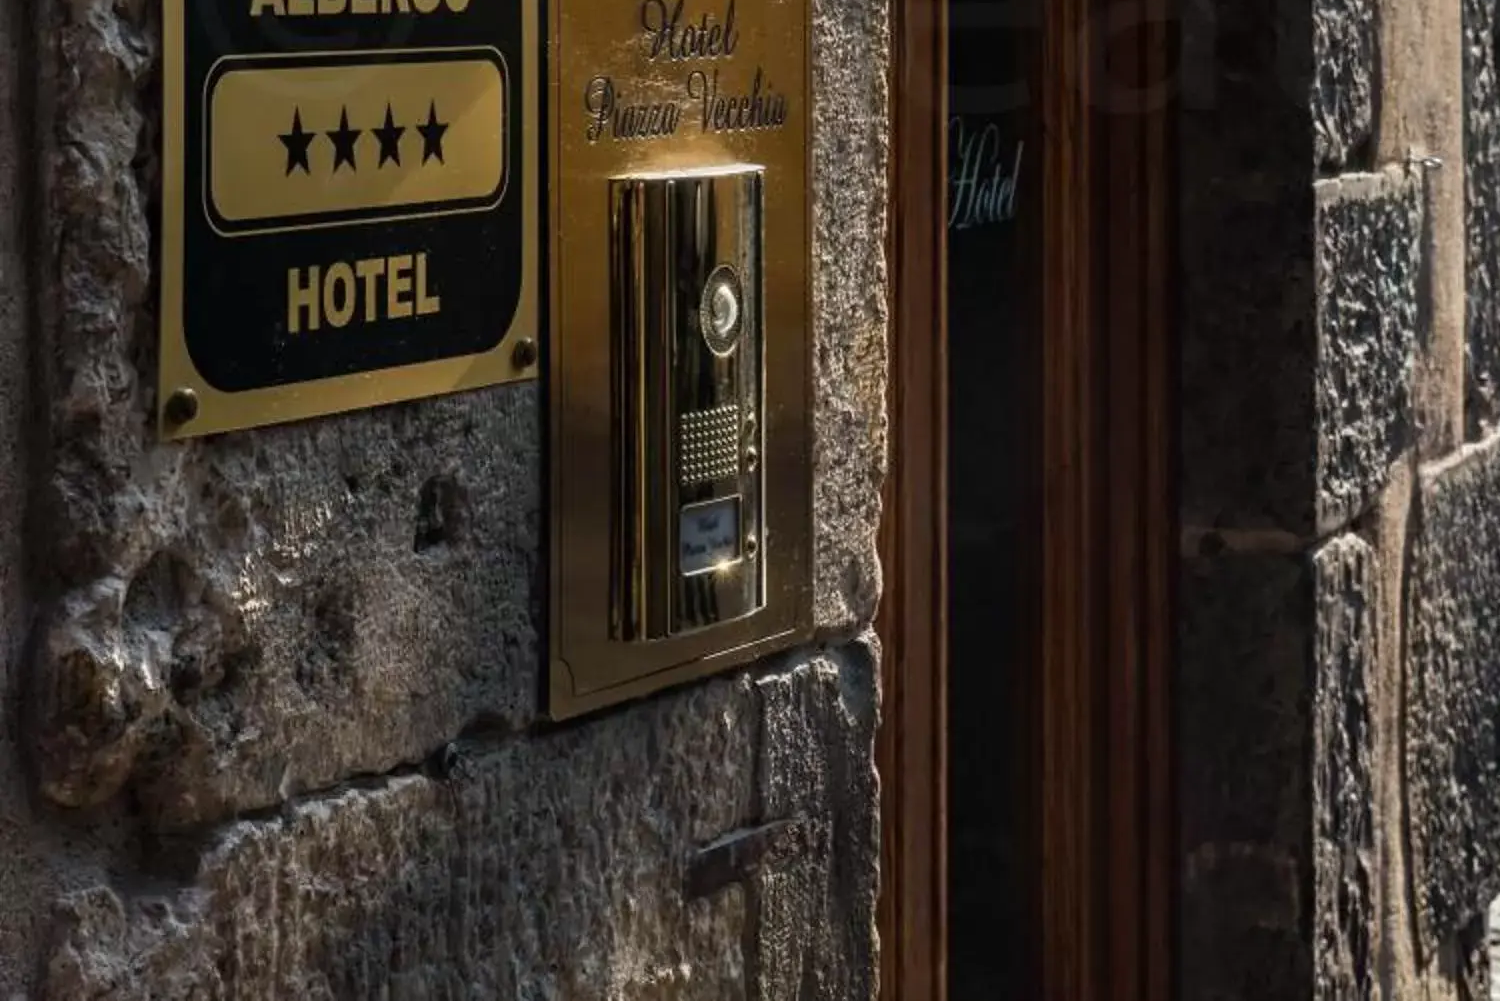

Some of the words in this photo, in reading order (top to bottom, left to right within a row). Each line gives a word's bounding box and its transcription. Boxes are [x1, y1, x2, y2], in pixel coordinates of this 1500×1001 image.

[585, 75, 680, 144] Piazza
[686, 65, 789, 134] Vecchia
[949, 115, 1025, 230] Hotel
[287, 252, 440, 333] HOTEL
